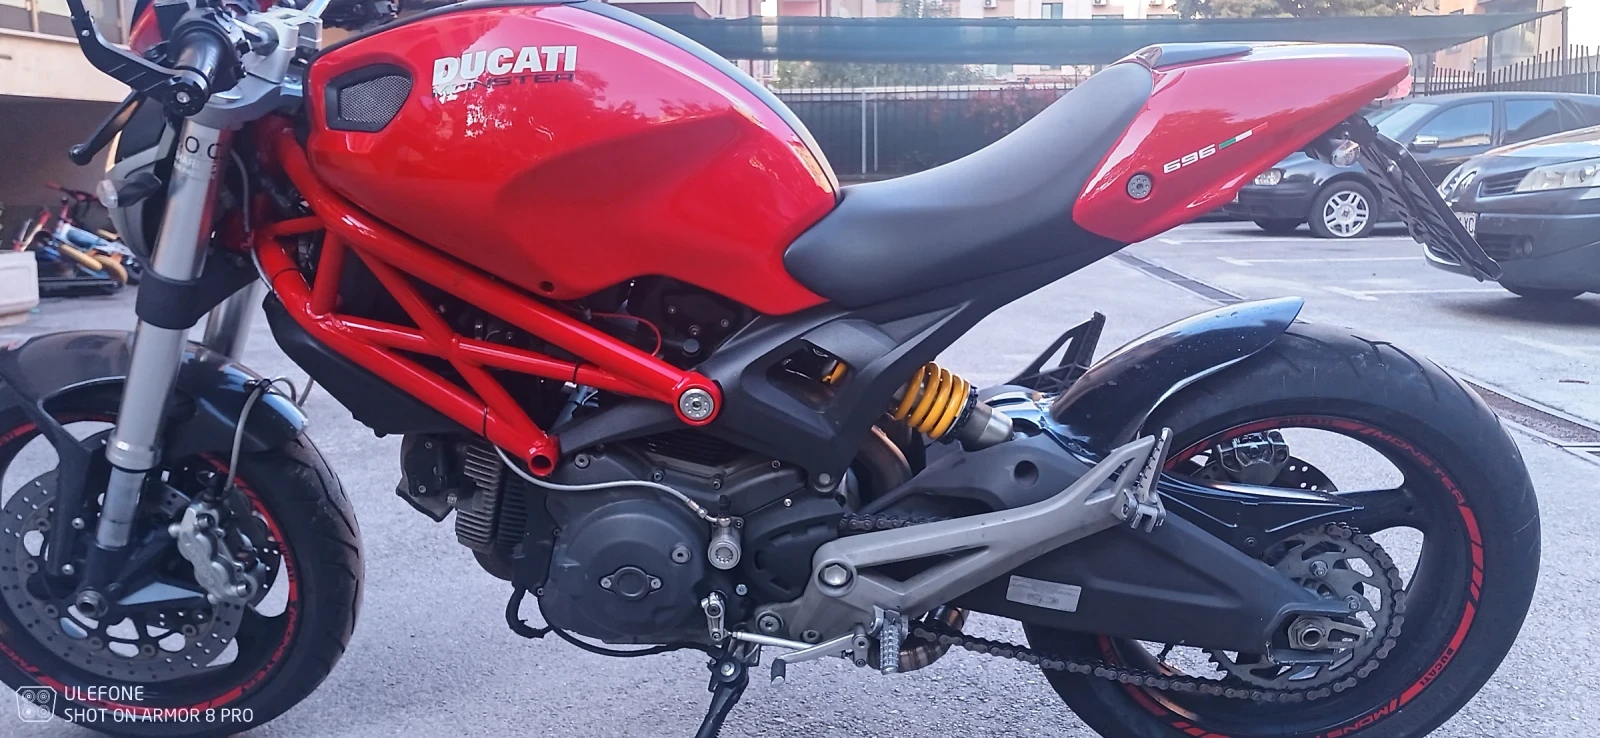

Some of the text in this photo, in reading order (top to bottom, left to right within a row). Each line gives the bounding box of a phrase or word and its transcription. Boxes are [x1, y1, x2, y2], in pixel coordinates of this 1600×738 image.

[432, 45, 578, 86] DUCATI
[1163, 143, 1216, 174] 696
[1373, 430, 1465, 505] MONSTER
[1419, 647, 1455, 687] DUCATI
